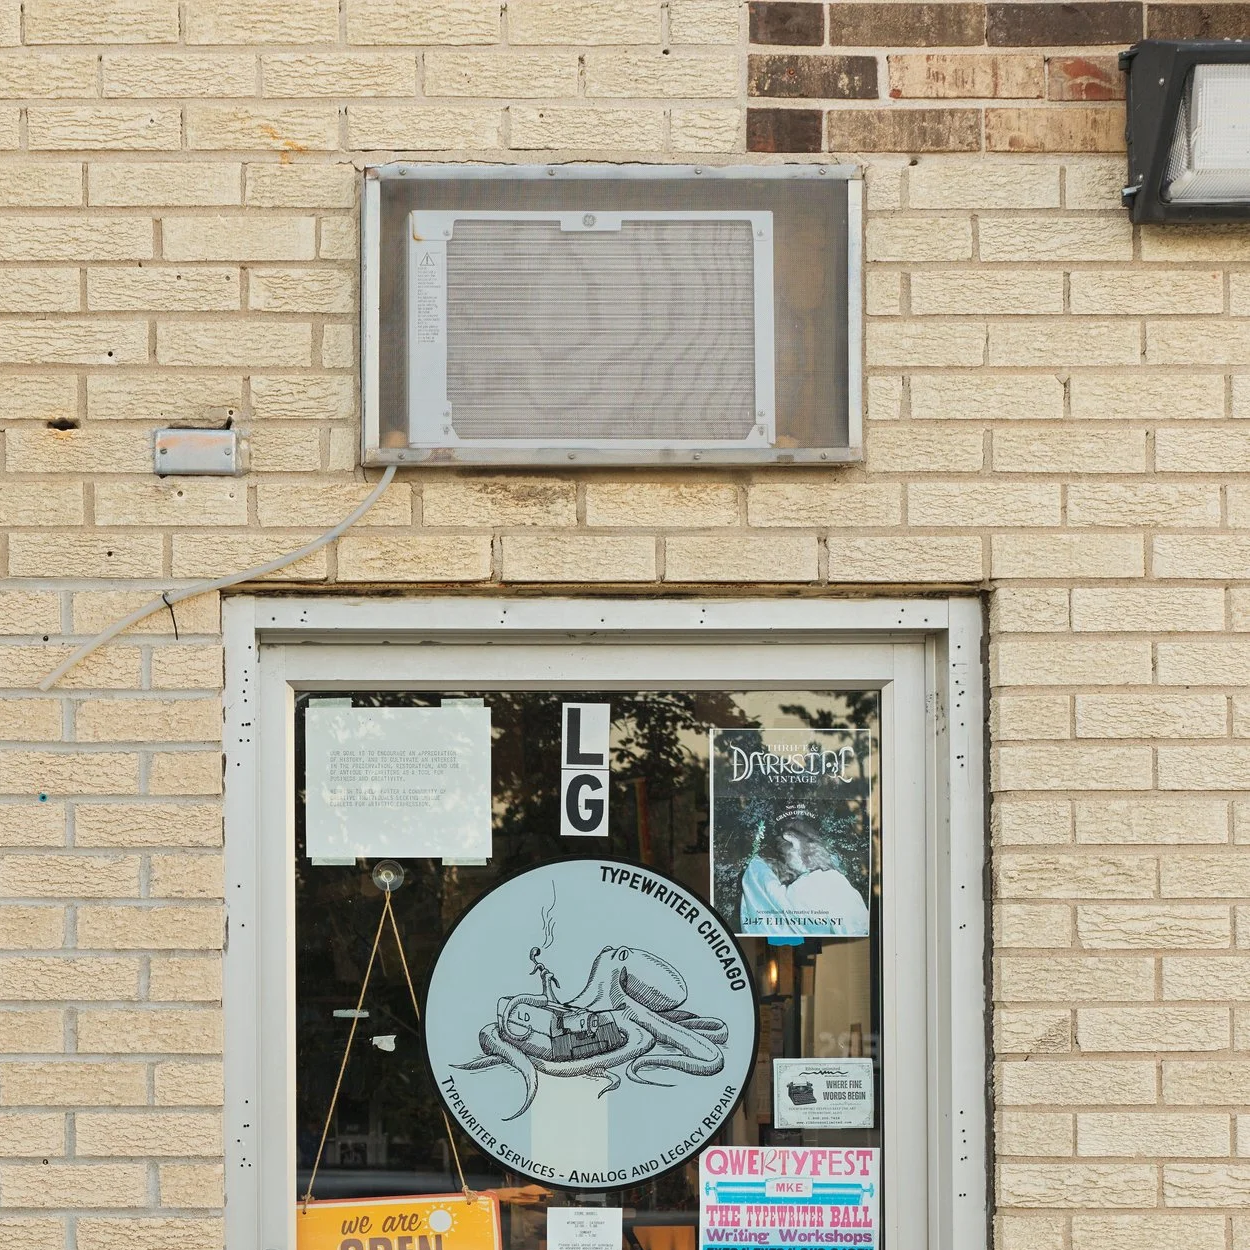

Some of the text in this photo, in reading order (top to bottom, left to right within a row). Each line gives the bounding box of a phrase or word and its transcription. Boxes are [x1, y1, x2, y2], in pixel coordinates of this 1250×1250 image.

[776, 810, 815, 821] GRAND OPENING
[600, 866, 746, 992] TYPEWRITER CHICAGO
[743, 918, 763, 926] 2147
[775, 918, 828, 926] HASTINGS
[826, 1080, 862, 1089] WHERE FINE
[823, 1092, 866, 1100] WORDS BEGIN
[440, 1075, 498, 1149] TYPEWRITER
[496, 1143, 556, 1179] SERVICES
[568, 1168, 627, 1183] ANALOG
[631, 1159, 660, 1179] AND
[660, 1128, 705, 1165] LEGACY
[702, 1084, 737, 1130] REPAIR
[705, 1149, 873, 1176] QWERTYFEST
[776, 1183, 803, 1192] MKE
[341, 1211, 423, 1235] we are
[706, 1205, 873, 1228] THE TYPEWRITER BALL
[706, 1228, 873, 1245] Writing Workshops
